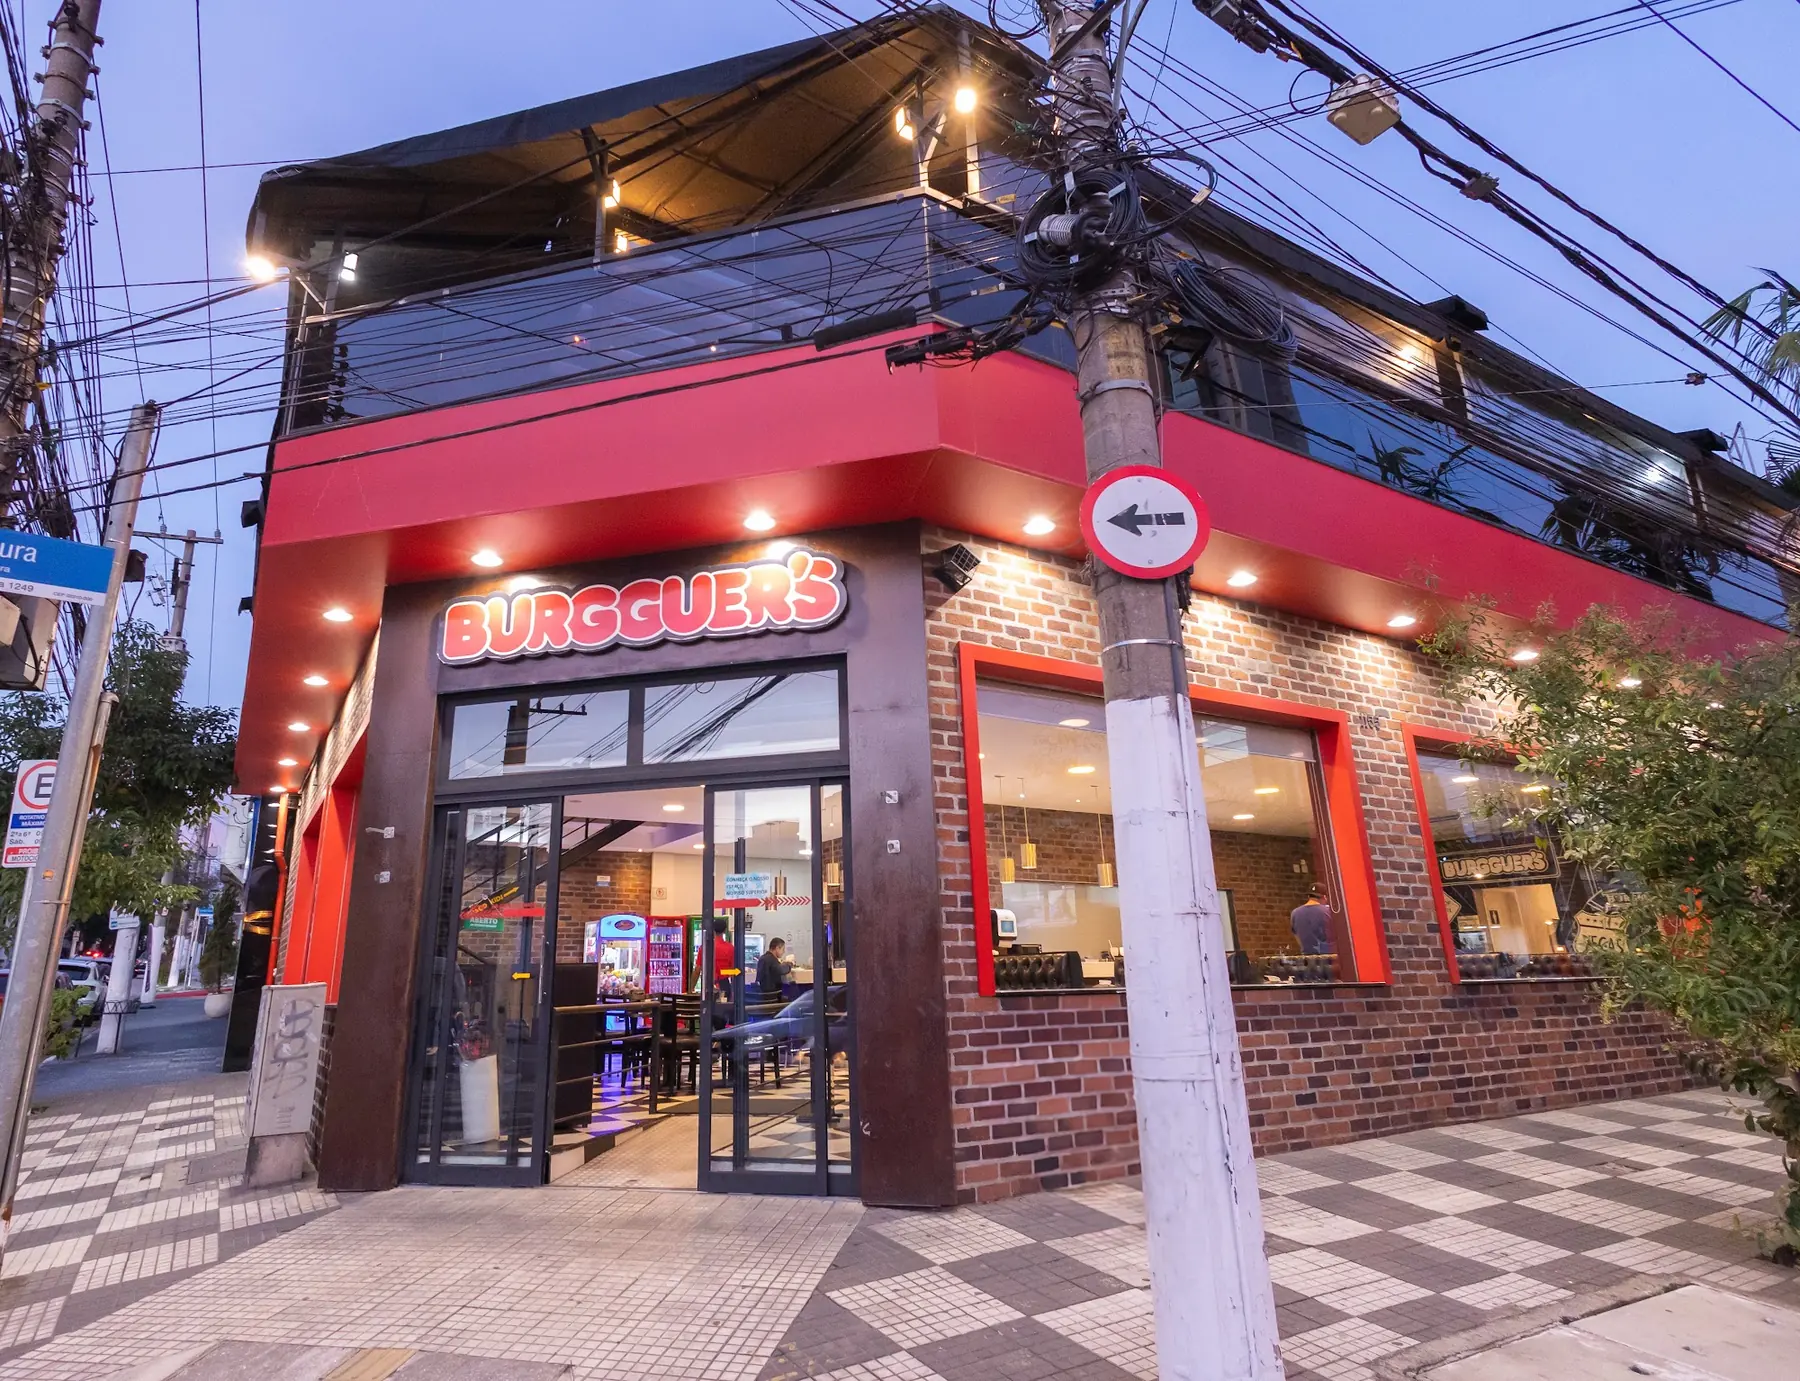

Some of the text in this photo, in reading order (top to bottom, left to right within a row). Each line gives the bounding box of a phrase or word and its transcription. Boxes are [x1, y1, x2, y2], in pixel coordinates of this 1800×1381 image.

[9, 582, 34, 593] 1249
[441, 550, 840, 661] BURGGUER'S
[34, 773, 55, 798] E
[1442, 849, 1549, 880] BURGGUER'S
